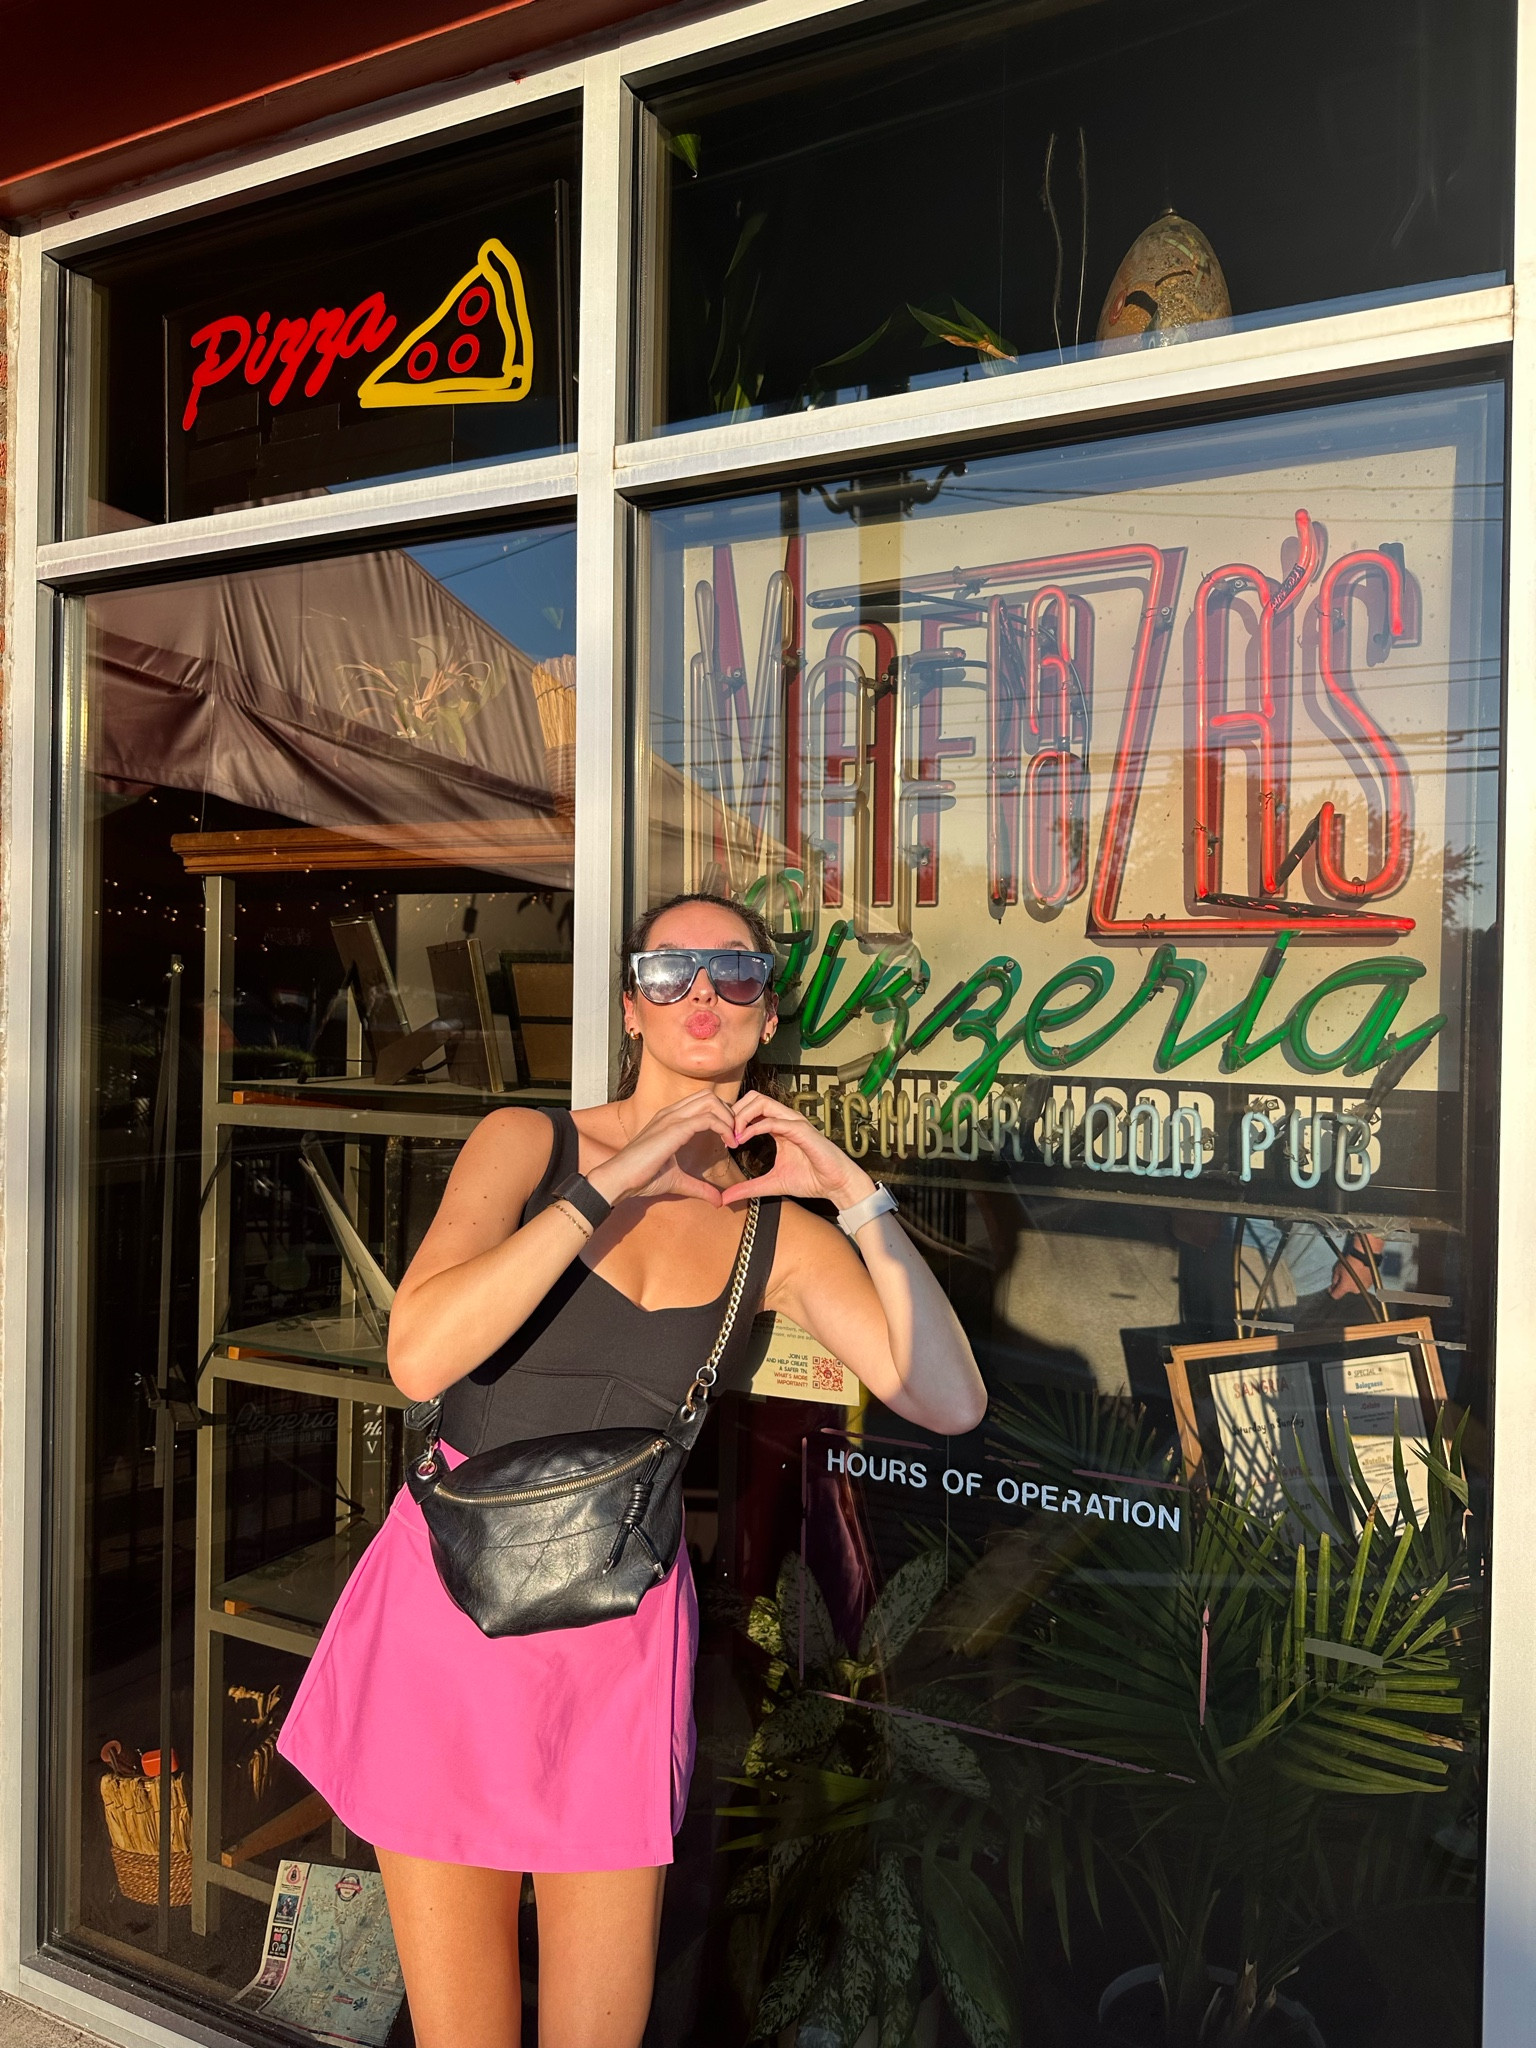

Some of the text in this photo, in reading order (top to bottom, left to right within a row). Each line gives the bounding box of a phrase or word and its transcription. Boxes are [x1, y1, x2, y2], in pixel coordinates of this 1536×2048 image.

[182, 291, 397, 431] Pizza
[1240, 1092, 1382, 1192] PUB
[777, 1379, 808, 1387] IMPORTANT?
[1233, 1376, 1290, 1399] SANGRIA
[827, 1448, 1181, 1533] HOURS OF OPERATION
